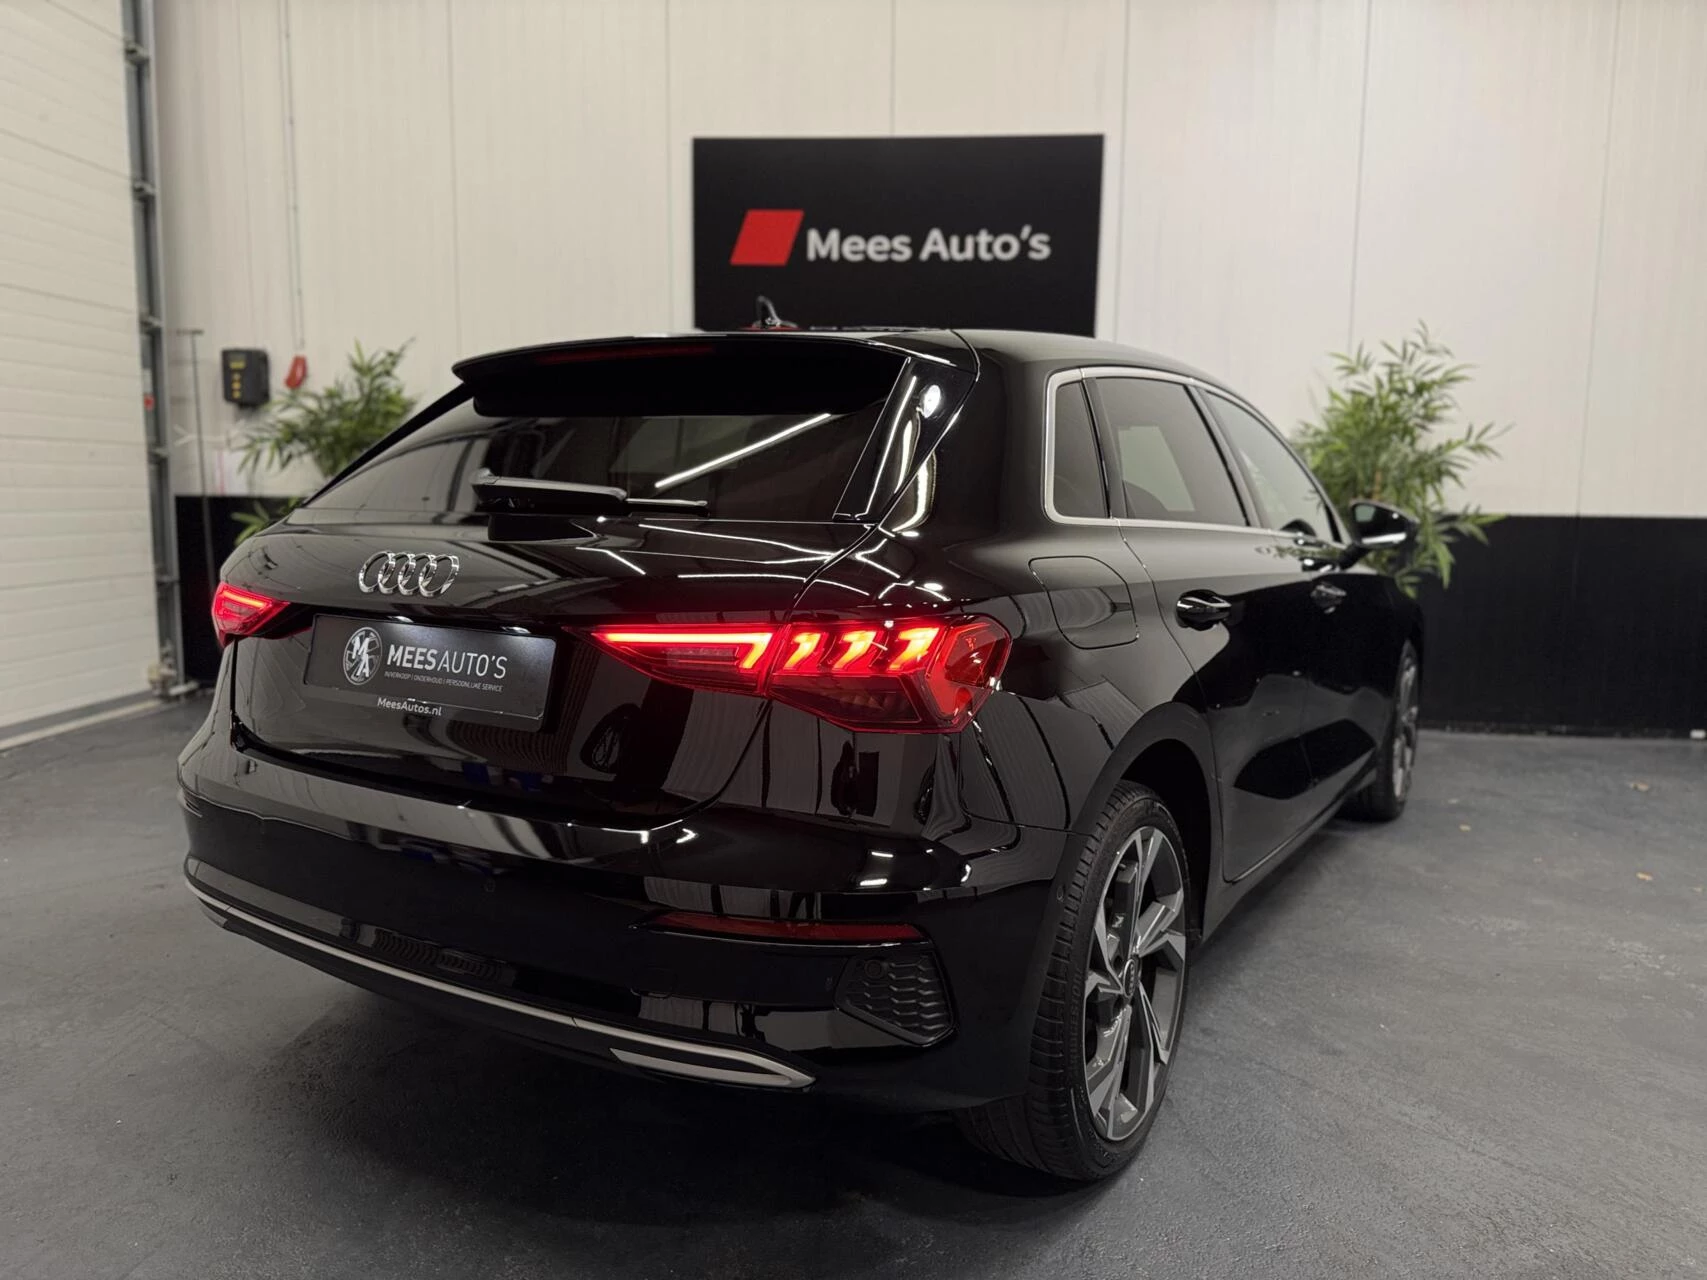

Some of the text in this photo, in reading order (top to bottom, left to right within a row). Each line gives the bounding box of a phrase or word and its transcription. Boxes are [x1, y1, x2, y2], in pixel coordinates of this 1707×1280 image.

[806, 224, 1051, 262] Mees Auto's
[387, 644, 438, 671] MEES
[482, 683, 503, 692] SERVICE
[377, 697, 442, 716] MeesAutos.nl
